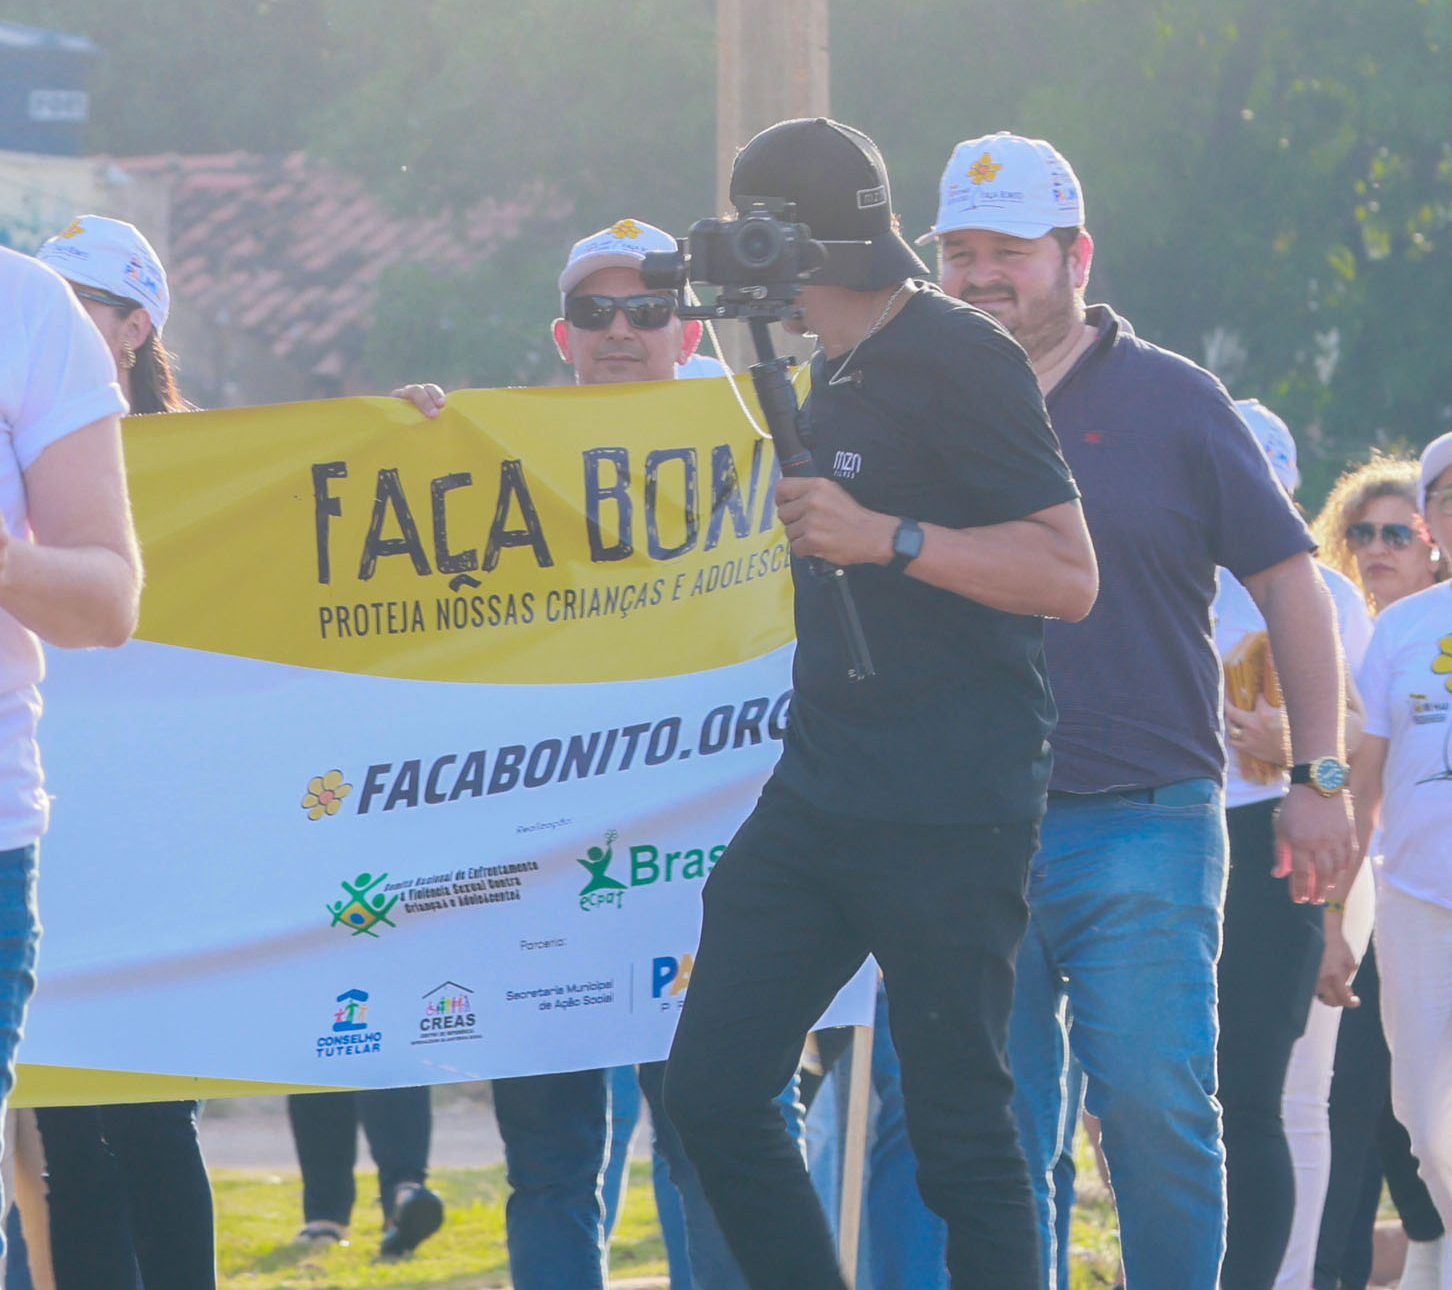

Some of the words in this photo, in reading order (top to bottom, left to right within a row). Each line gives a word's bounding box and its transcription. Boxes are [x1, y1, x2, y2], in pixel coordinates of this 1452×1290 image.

[311, 459, 554, 592] FAÇA
[320, 600, 426, 639] PROTEJA
[436, 591, 536, 631] NOSSAS
[546, 578, 664, 623] CRIANÇAS
[673, 572, 686, 602] E
[506, 984, 564, 1001] Secretaria
[566, 979, 614, 995] Municipal
[539, 1000, 551, 1011] de
[555, 996, 580, 1010] Ação
[582, 990, 614, 1006] Social
[420, 1013, 476, 1031] CREAS
[316, 1043, 380, 1058] TUTELAR
[317, 1032, 382, 1048] CONSELHO
